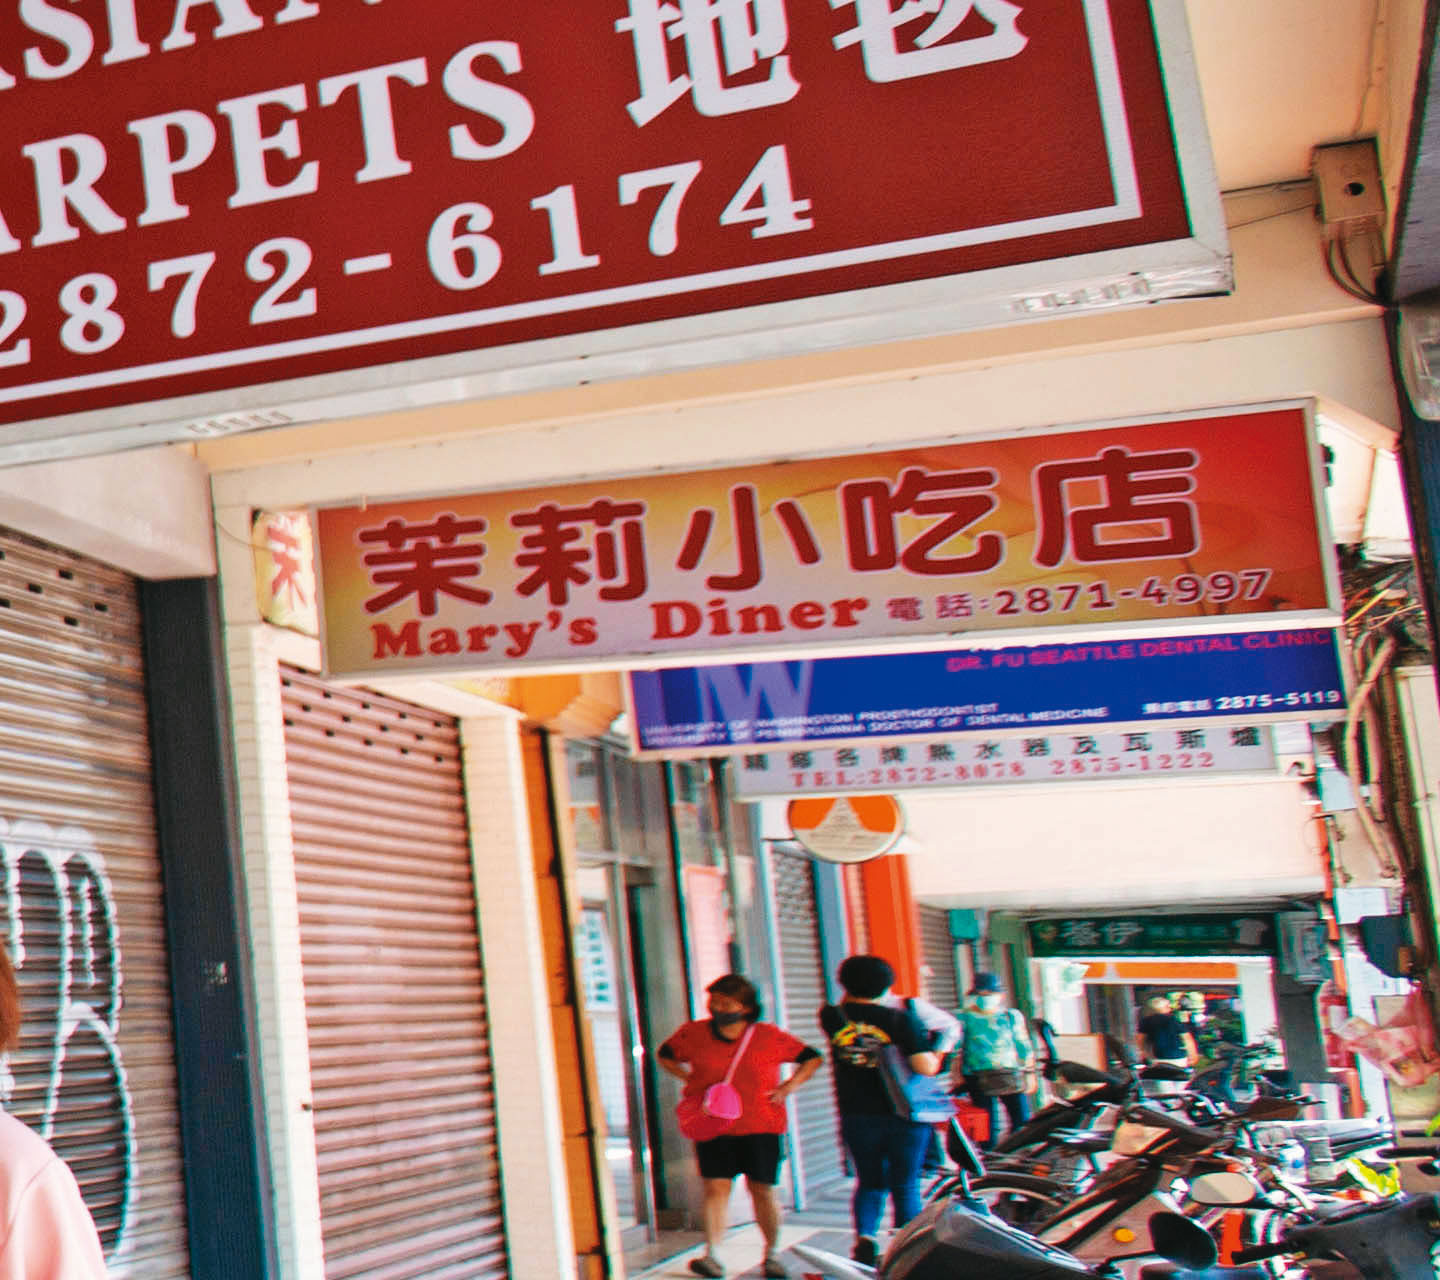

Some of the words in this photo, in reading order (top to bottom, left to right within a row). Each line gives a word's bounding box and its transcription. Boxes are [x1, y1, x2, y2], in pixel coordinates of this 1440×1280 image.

[359, 446, 1199, 616] 茉莉小吃店
[370, 609, 599, 660] Mary's
[650, 594, 870, 643] Diner
[992, 653, 1025, 669] FU
[1029, 644, 1137, 666] SEATTLE
[1140, 637, 1239, 658] DENTAL
[1243, 630, 1332, 650] CLINIC
[1215, 689, 1342, 711] 2875-5119
